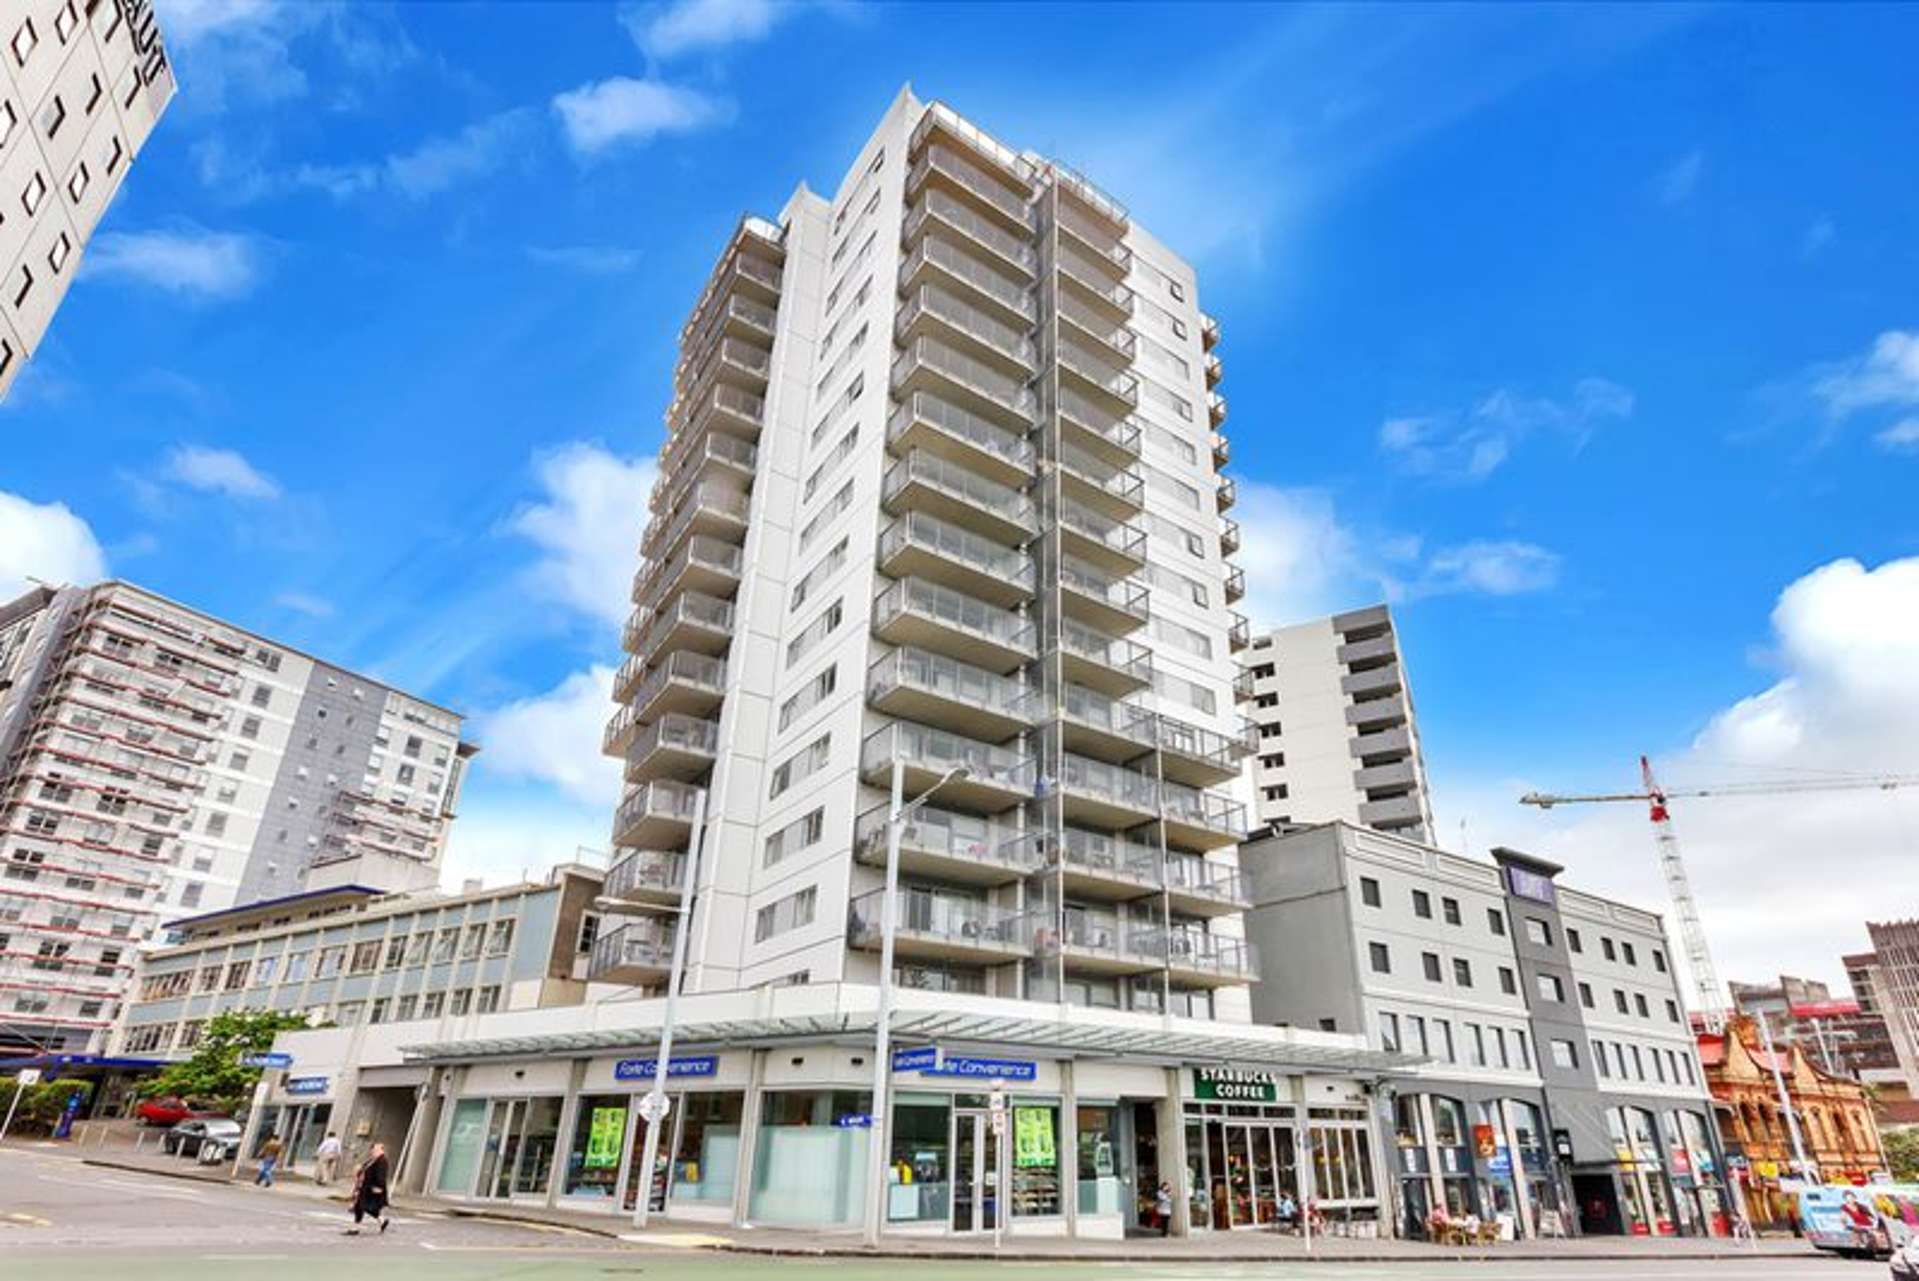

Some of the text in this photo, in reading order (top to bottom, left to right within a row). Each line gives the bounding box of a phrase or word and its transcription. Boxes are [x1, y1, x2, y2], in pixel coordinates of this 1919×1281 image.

[644, 1060, 711, 1074] Coenience
[959, 1060, 1032, 1076] Convenience
[1200, 1067, 1277, 1084] STARBUCKS
[1216, 1084, 1265, 1098] COFFEE
